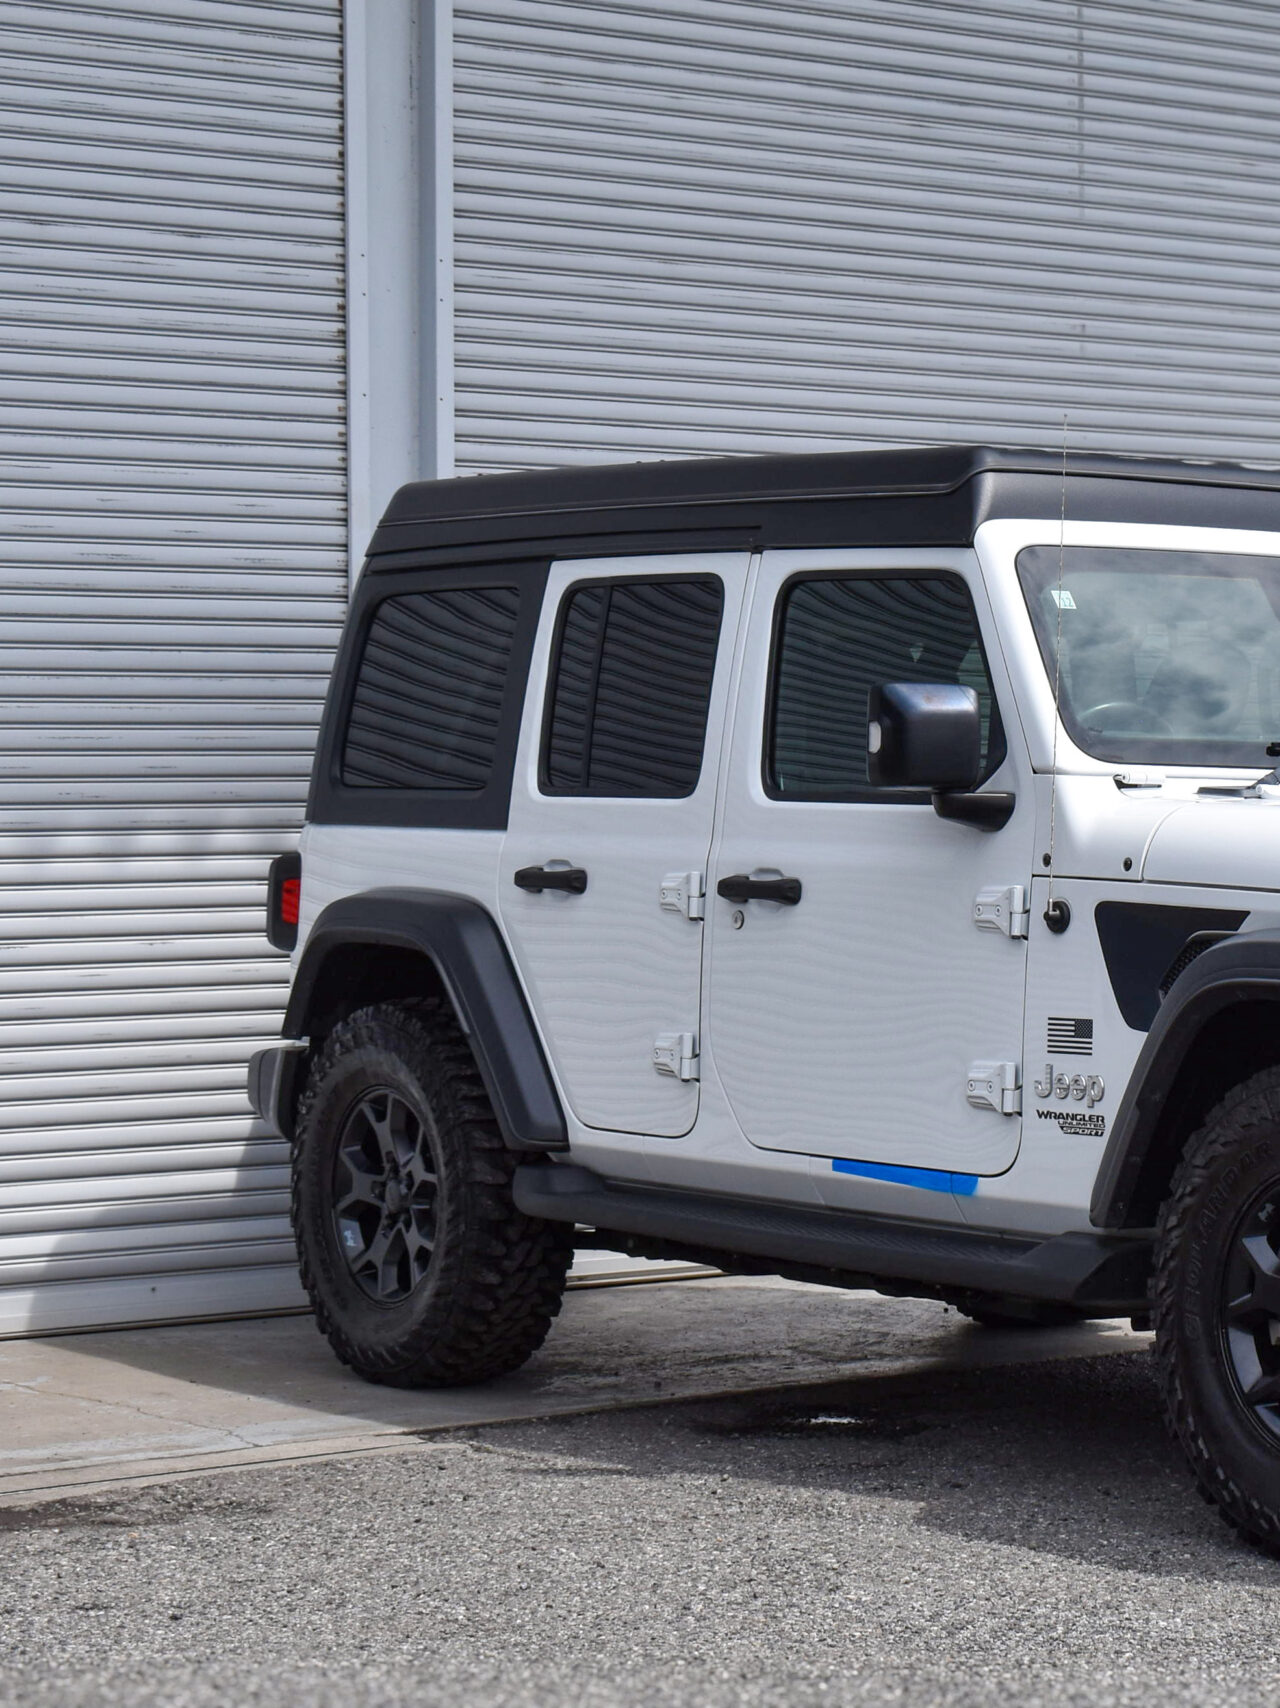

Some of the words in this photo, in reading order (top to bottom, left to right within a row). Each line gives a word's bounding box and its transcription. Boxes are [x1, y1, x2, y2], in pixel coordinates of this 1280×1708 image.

[1034, 1064, 1105, 1108] Jeep
[1036, 1109, 1105, 1123] WRANGLER
[1057, 1120, 1106, 1129] UNLIMITED
[1062, 1126, 1105, 1136] SPORT
